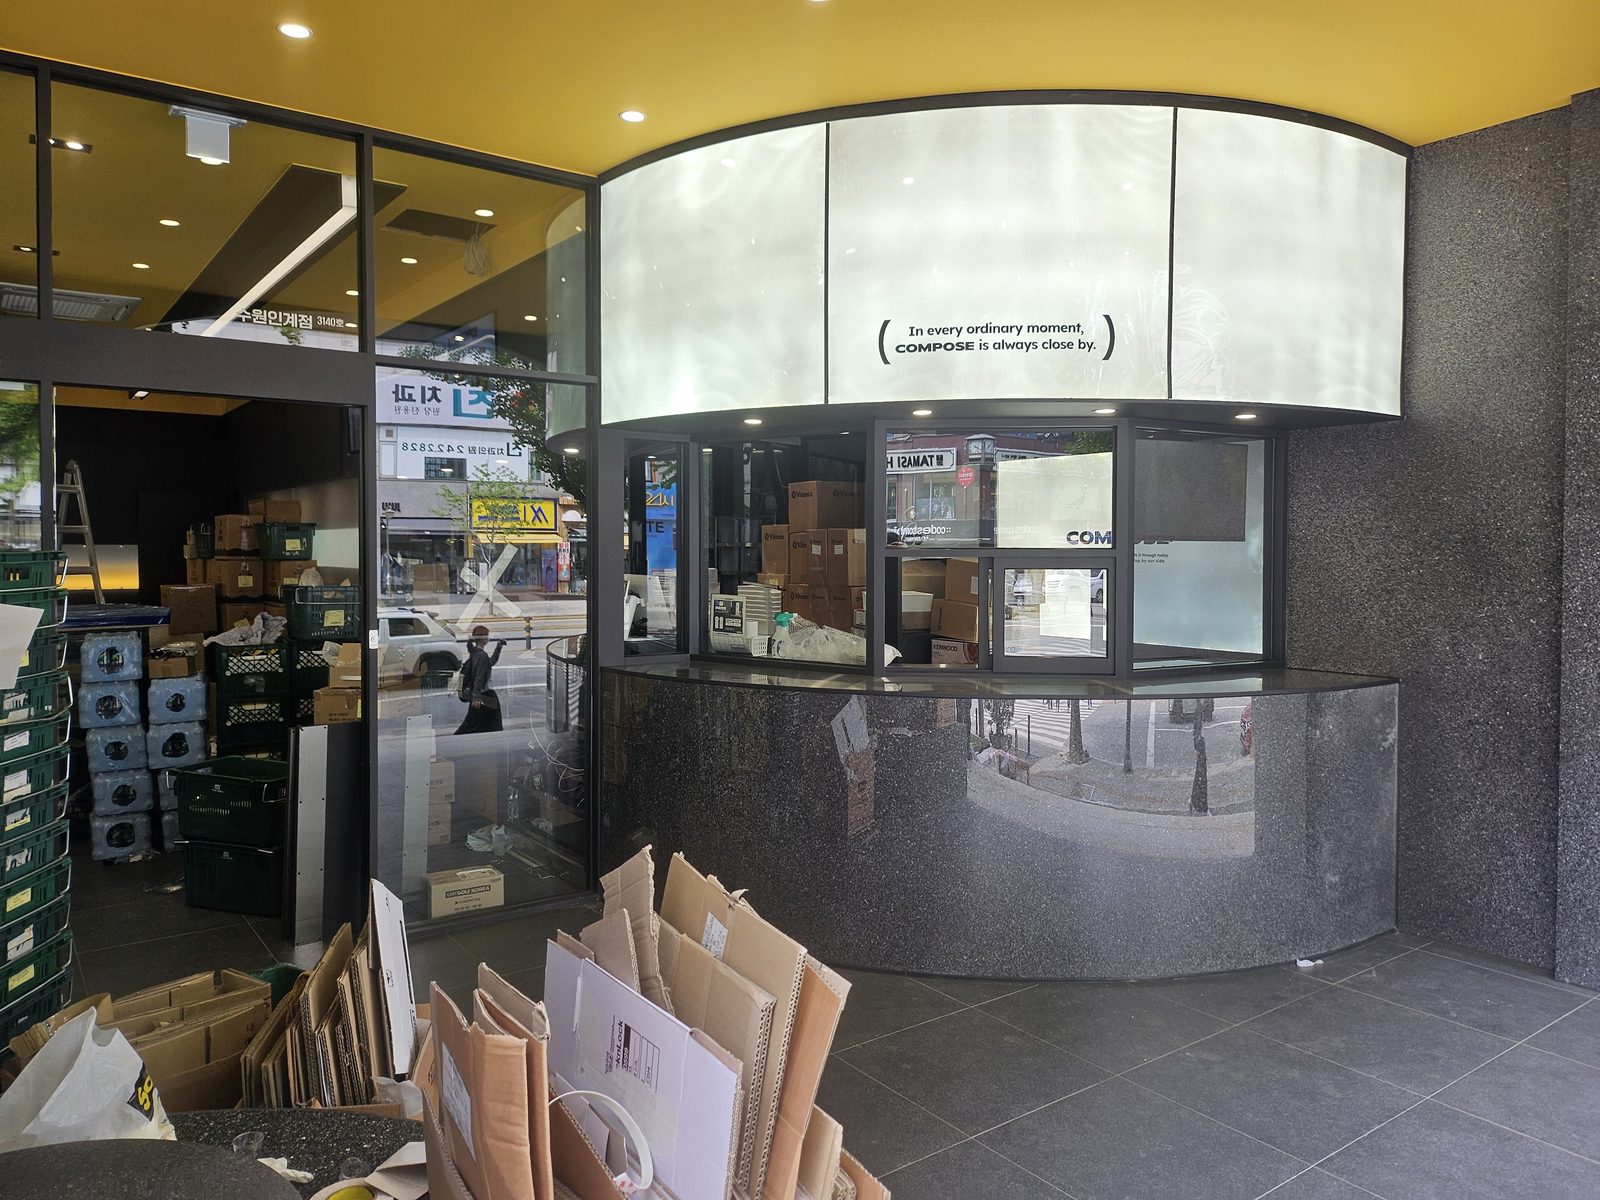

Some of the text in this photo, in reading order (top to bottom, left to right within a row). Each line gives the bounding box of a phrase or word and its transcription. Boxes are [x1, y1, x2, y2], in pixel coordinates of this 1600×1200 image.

[908, 322, 1085, 337] In every ordinary moment,
[895, 337, 1097, 354] COMPOSE is always close by.
[933, 644, 958, 652] KENWOOD
